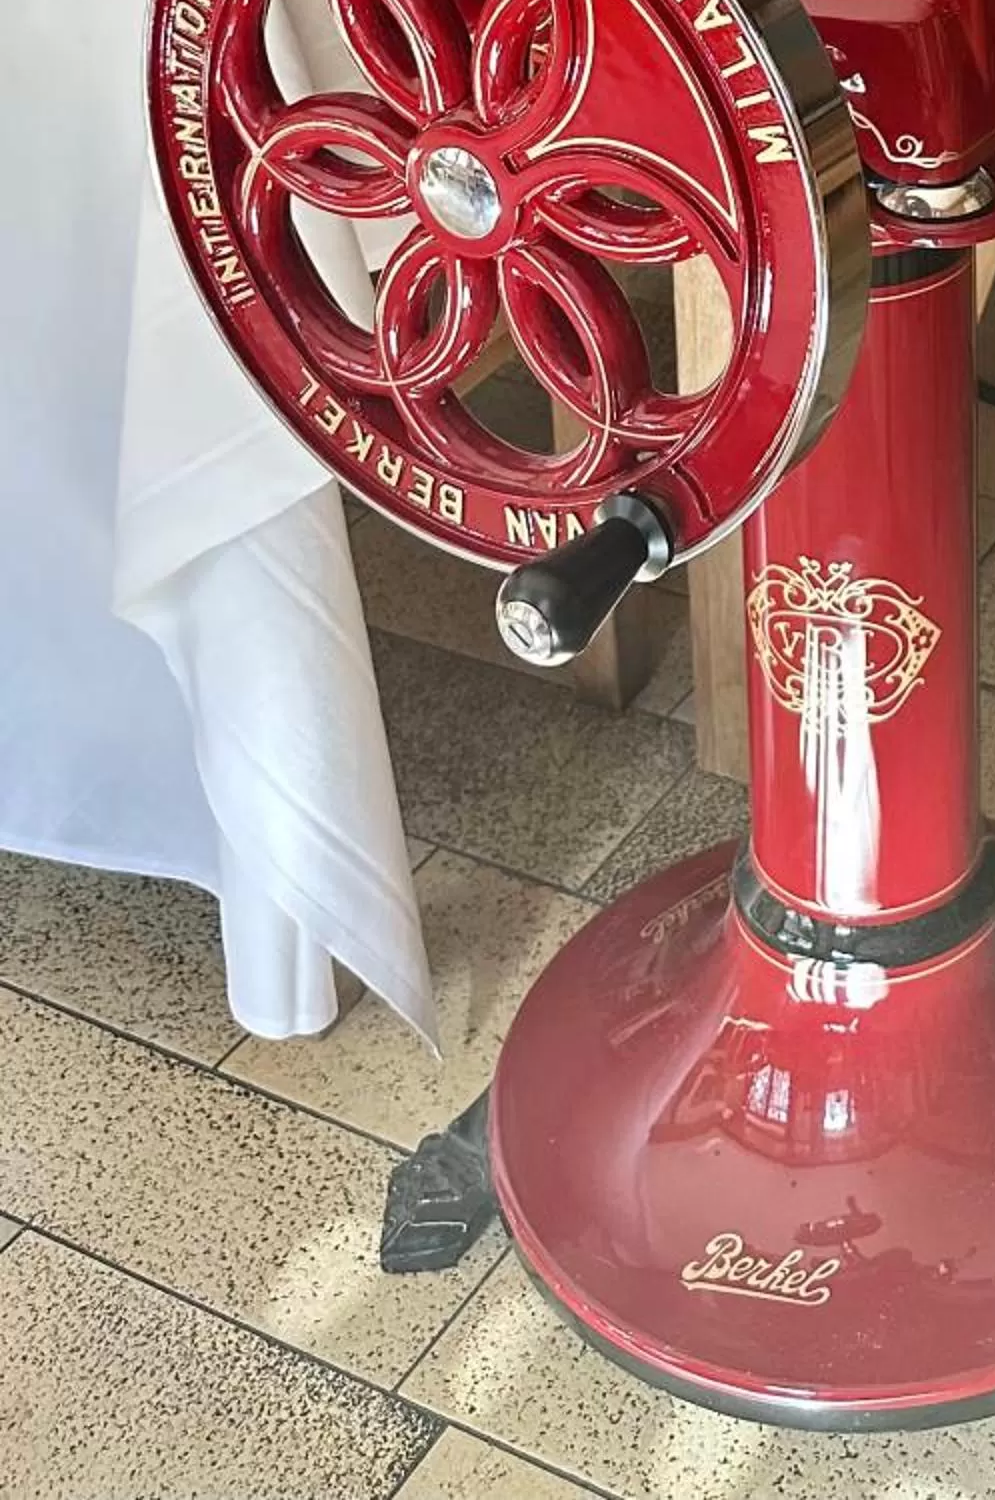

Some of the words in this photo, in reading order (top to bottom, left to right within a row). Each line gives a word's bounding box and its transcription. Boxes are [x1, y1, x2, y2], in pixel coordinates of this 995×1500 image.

[298, 366, 465, 526] BERKEL
[504, 505, 586, 550] VAN
[679, 1232, 841, 1306] Berkel
